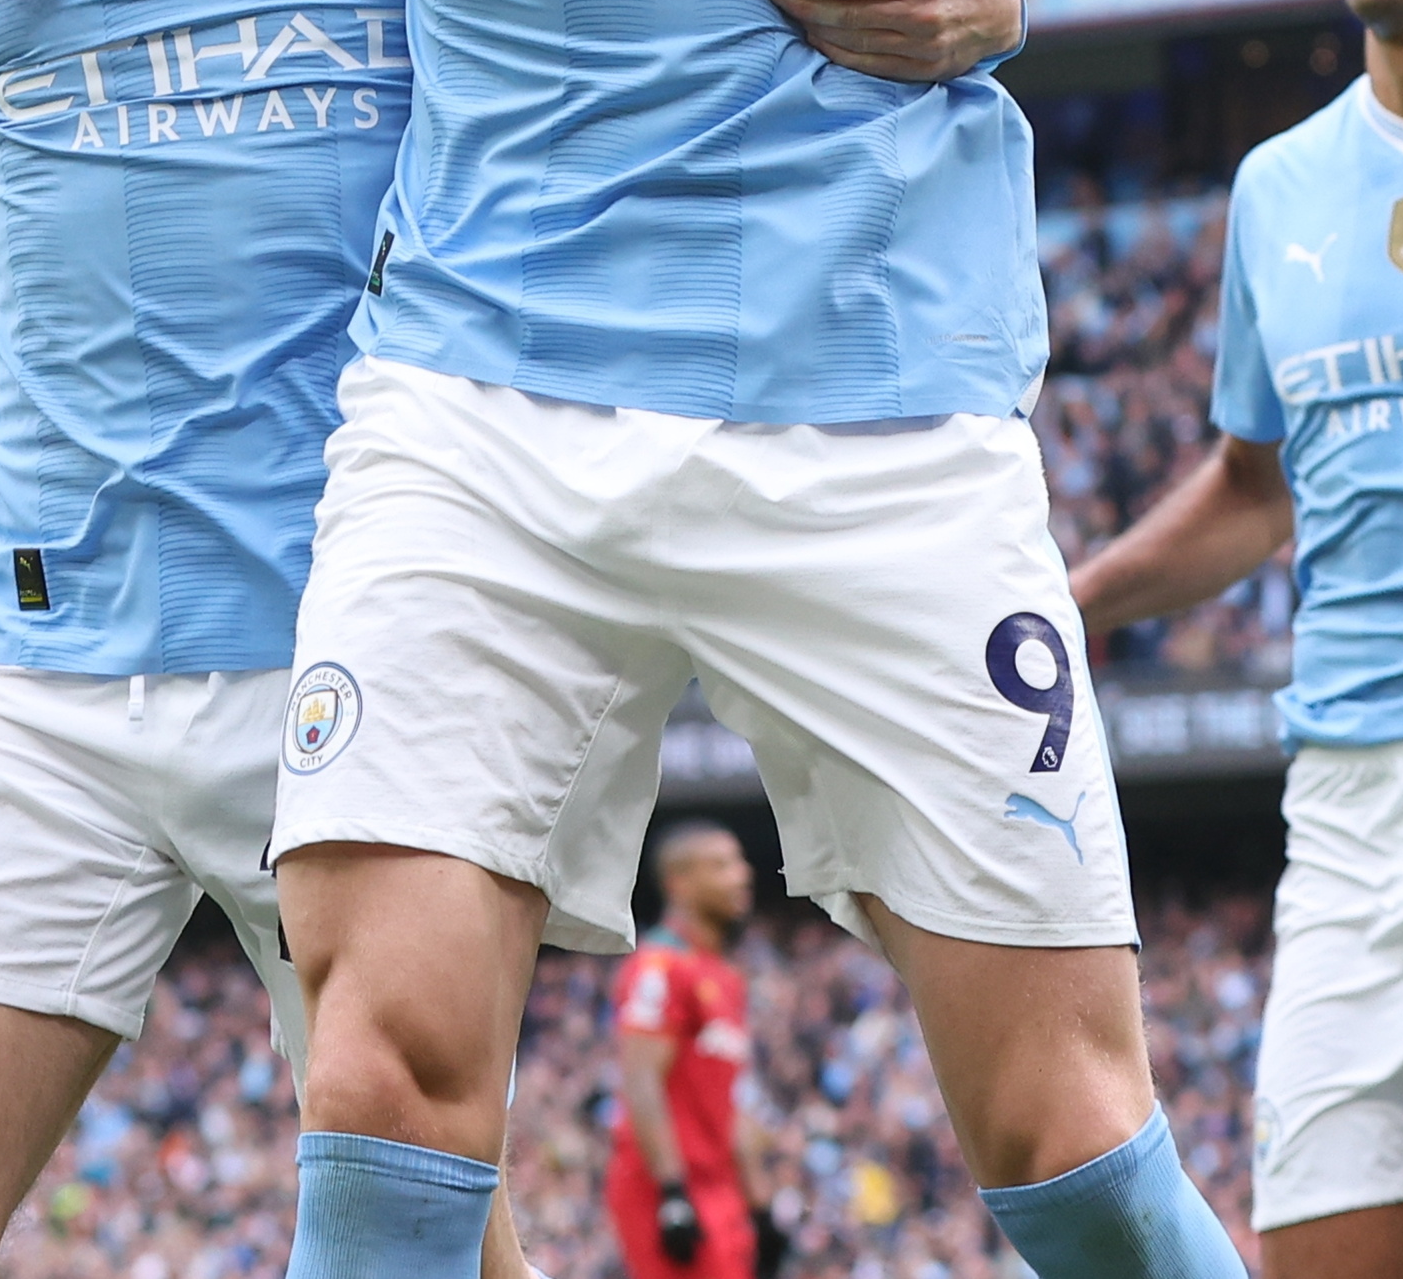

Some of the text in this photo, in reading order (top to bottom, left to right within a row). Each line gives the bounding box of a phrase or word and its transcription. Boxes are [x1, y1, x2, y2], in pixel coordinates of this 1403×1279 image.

[70, 86, 381, 151] AIRWAYS
[290, 671, 352, 712] MANCHESTER
[985, 611, 1075, 774] 9
[299, 754, 325, 769] CITY
